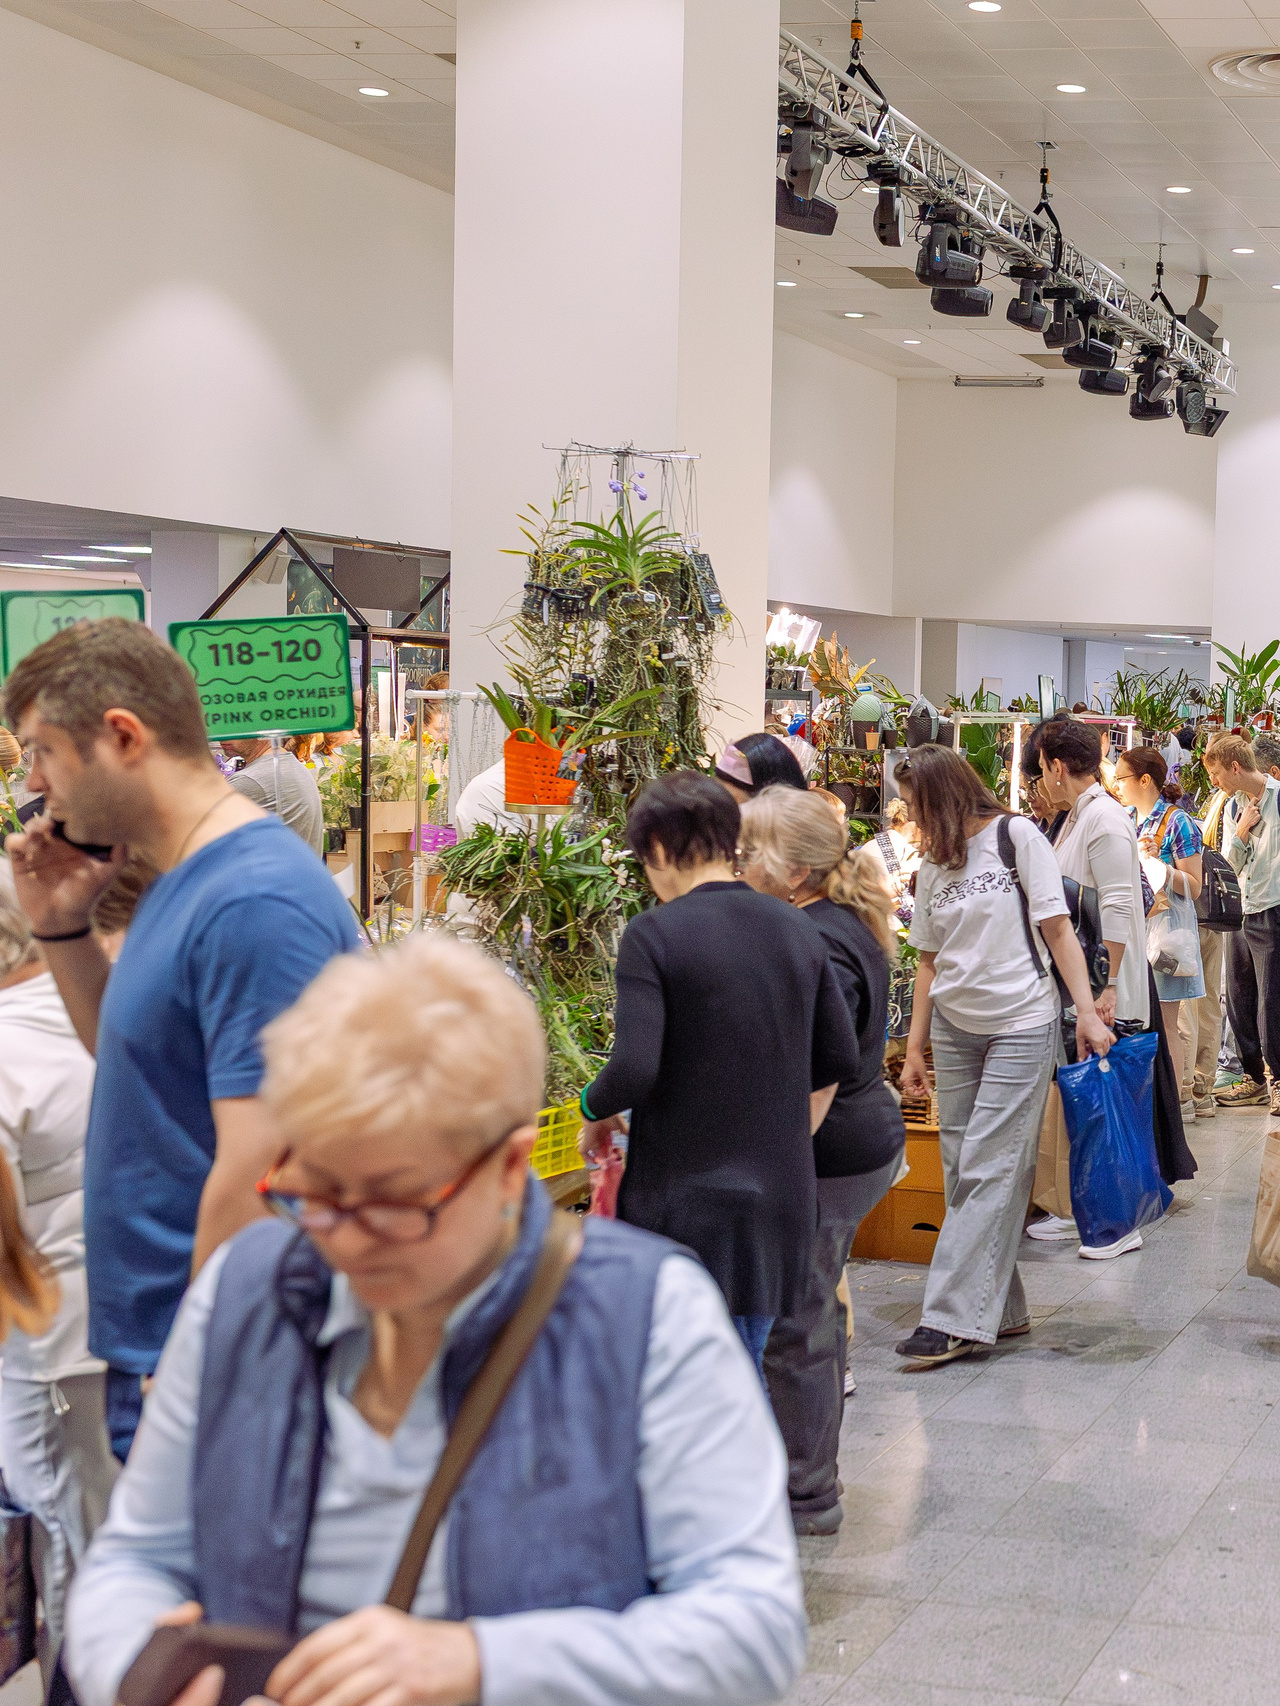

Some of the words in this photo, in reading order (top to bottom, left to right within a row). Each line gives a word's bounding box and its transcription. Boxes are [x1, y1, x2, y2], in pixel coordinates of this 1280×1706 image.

[208, 638, 321, 666] 118-120
[199, 690, 268, 706] ОЗОВАЯ
[273, 686, 347, 701] ОРХИДЕЯ
[204, 710, 253, 727] (PINK
[260, 704, 336, 722] ORCHID)
